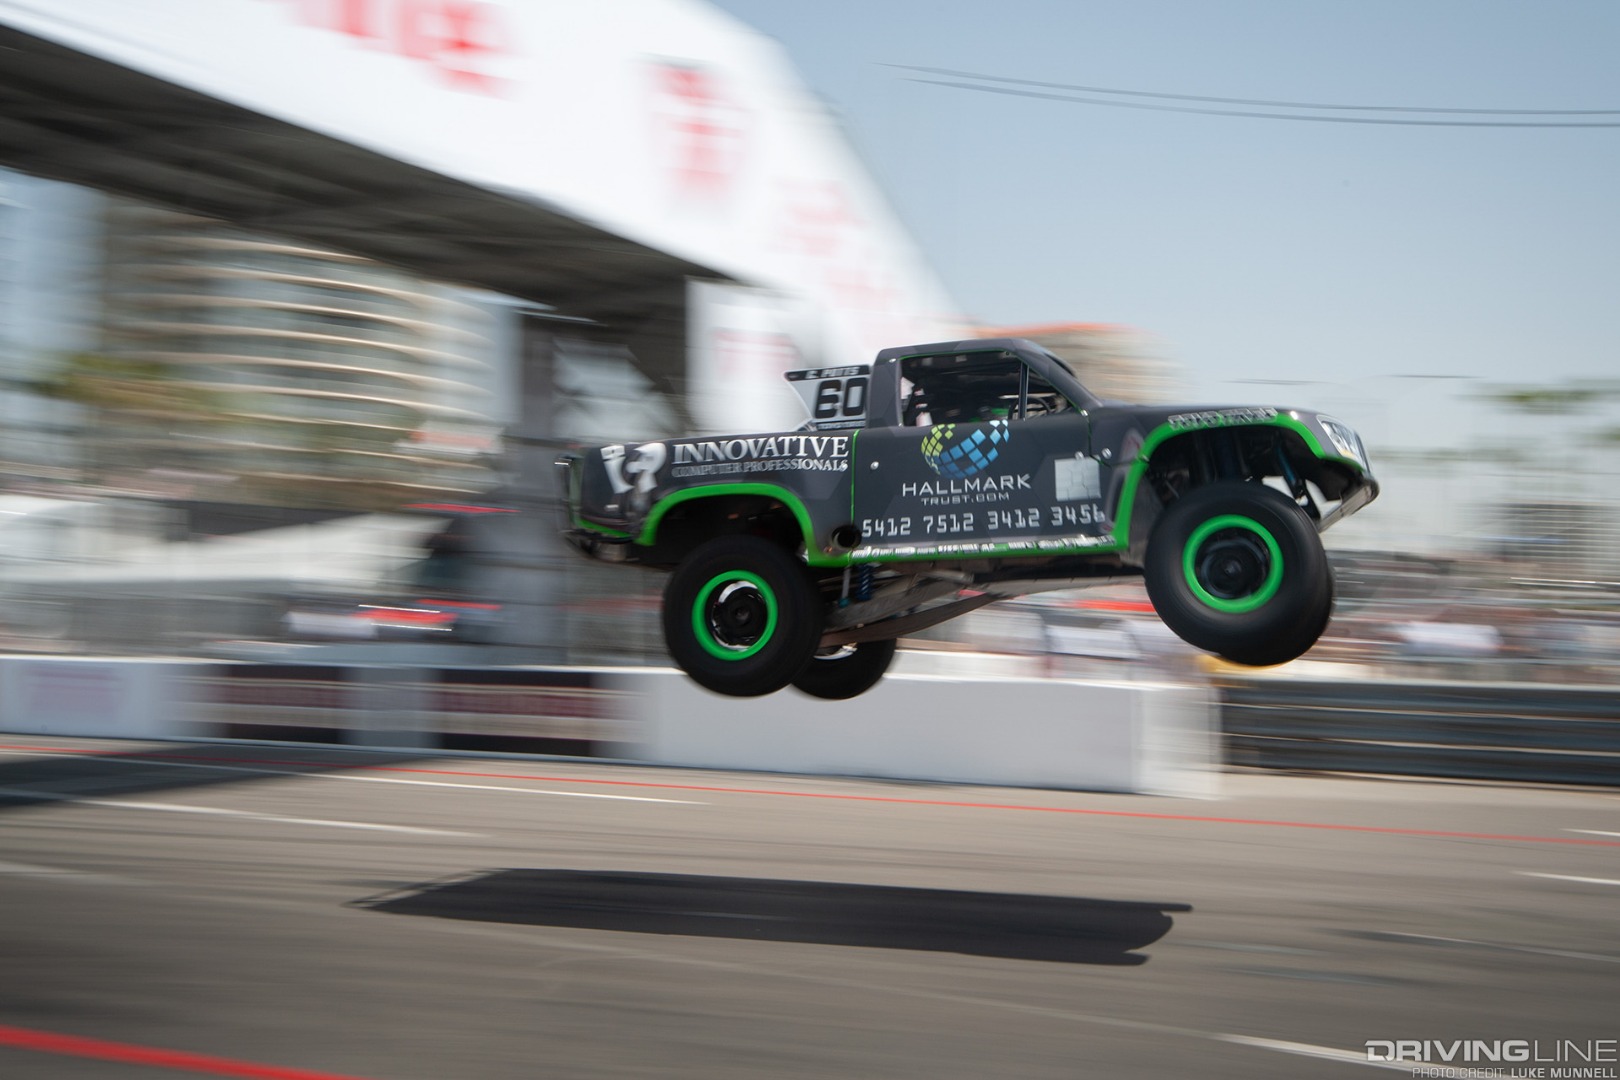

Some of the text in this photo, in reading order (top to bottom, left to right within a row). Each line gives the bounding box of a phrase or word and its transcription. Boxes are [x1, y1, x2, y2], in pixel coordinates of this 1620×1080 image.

[814, 377, 868, 419] 60
[672, 436, 849, 464] INNOVATIVE
[671, 459, 848, 477] COMPUTER PROFESSIONALS
[902, 474, 1031, 497] HALLMARK
[921, 492, 1010, 506] TRUST.COM
[862, 503, 1106, 537] 5412 7512 3412 3456
